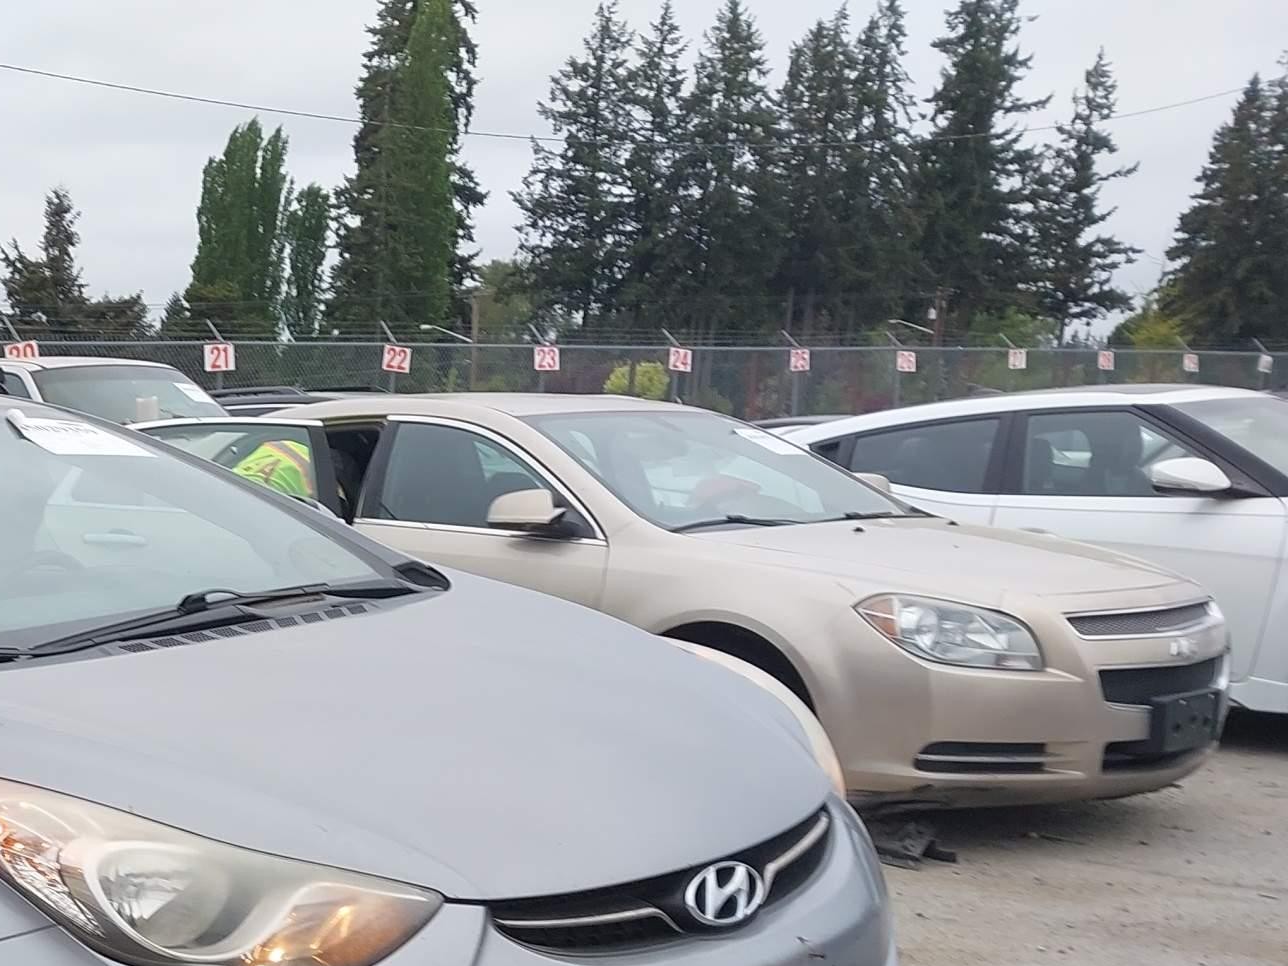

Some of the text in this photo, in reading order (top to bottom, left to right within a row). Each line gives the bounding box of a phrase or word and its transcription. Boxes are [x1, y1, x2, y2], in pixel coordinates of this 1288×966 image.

[210, 346, 229, 369] 21
[386, 348, 407, 370] 22
[536, 348, 556, 369] 23
[672, 350, 689, 369] 24
